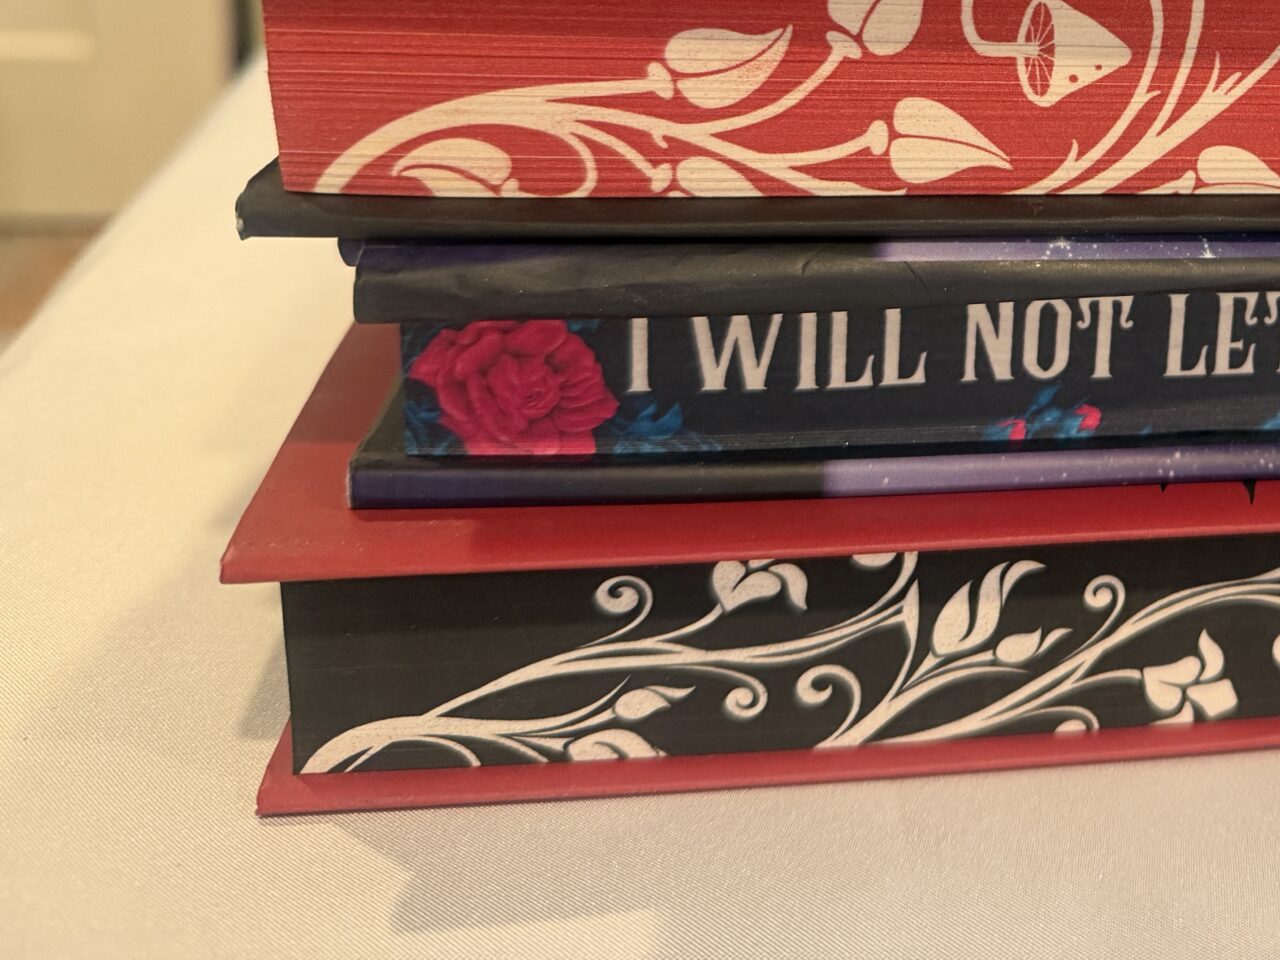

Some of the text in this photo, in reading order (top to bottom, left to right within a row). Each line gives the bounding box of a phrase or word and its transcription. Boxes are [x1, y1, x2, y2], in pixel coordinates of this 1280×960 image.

[626, 316, 651, 394] I
[691, 304, 928, 394] WILL
[960, 293, 1135, 383] NOT
